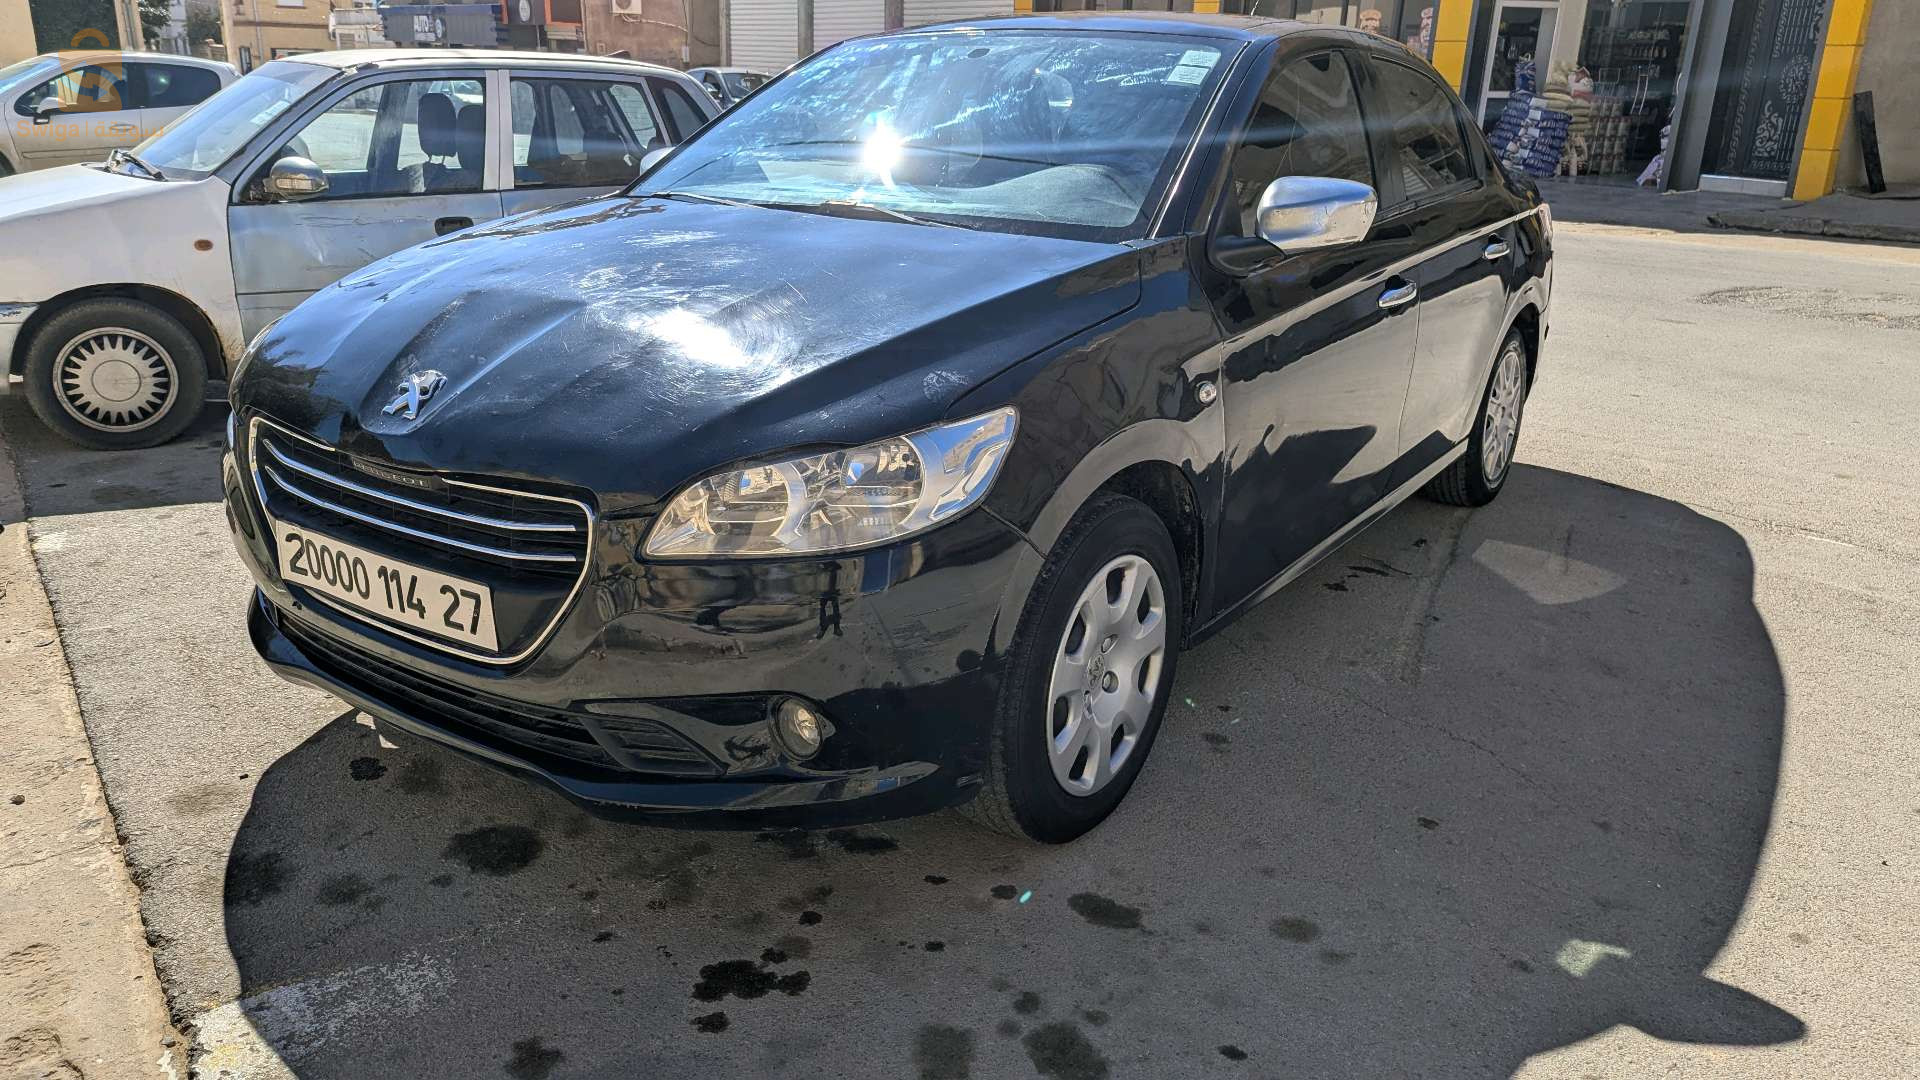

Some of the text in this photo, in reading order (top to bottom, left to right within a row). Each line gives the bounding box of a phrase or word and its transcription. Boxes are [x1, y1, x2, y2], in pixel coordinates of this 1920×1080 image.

[285, 532, 482, 636] 20000 114 27
